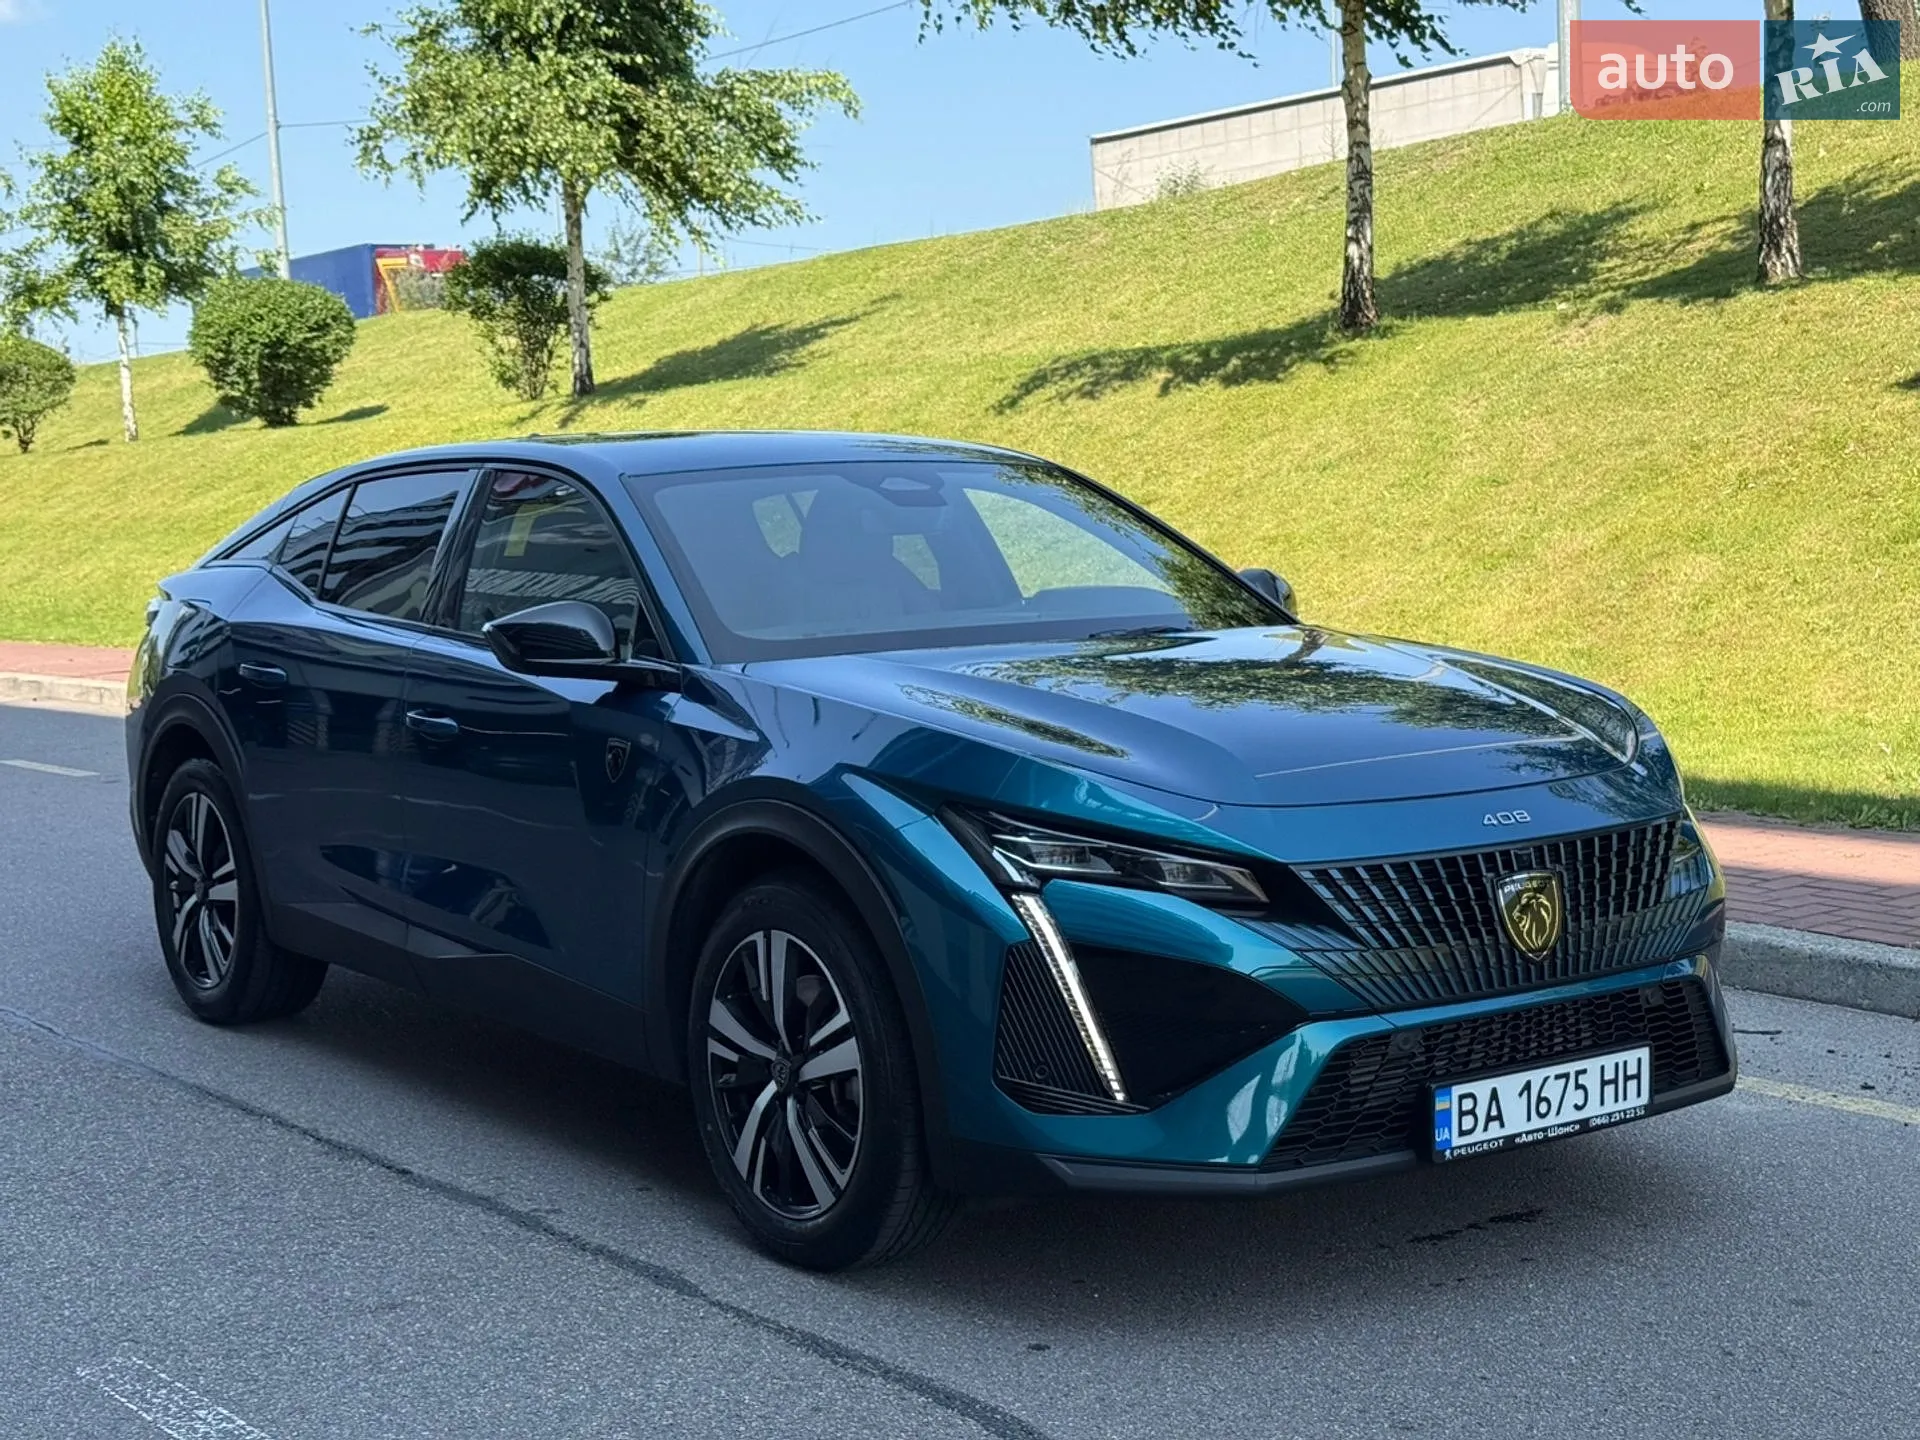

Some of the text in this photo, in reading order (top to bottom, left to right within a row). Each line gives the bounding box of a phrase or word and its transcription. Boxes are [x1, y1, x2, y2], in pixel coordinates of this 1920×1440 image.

[1482, 809, 1532, 827] 408
[1457, 1057, 1642, 1138] BA 1675 HH
[1435, 1127, 1450, 1141] UA
[1452, 1138, 1504, 1157] PEUGEOT
